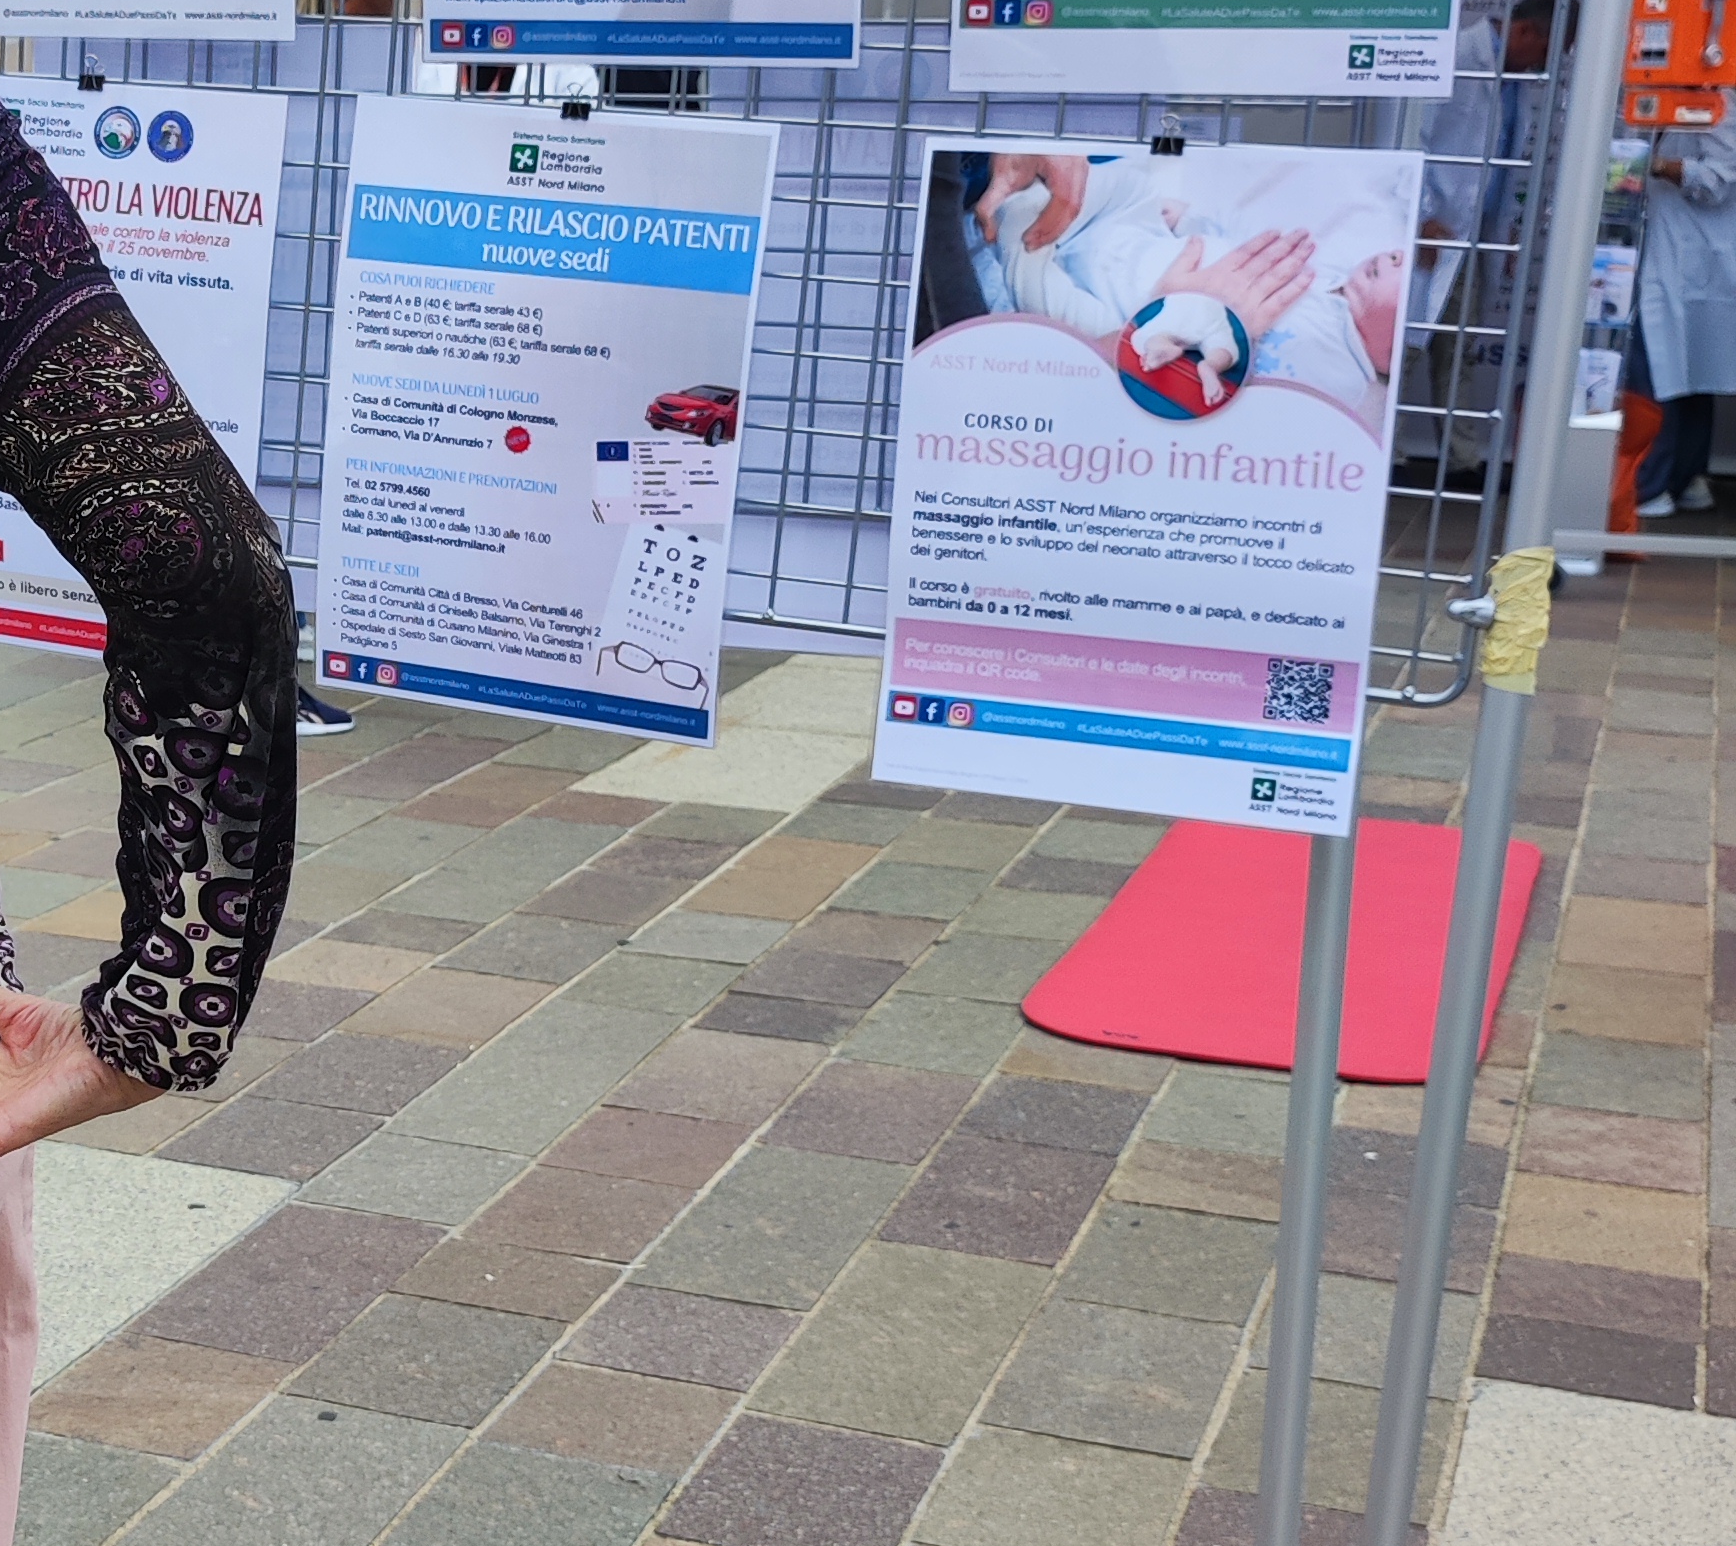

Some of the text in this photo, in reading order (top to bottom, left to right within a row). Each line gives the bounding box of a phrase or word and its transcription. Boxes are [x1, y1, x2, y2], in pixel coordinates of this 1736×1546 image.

[24, 114, 71, 127] Regione
[23, 126, 83, 139] Lombardia
[541, 150, 590, 164] Regione
[540, 161, 602, 175] Lombardia
[506, 176, 604, 192] ASST Nord Milano
[115, 181, 142, 216] LA
[152, 183, 262, 225] VIOLENZA
[359, 193, 750, 252] RINNOVO E RILASCIO PATENTI
[112, 227, 230, 247] contro la violenza
[482, 243, 610, 272] nuove sedi
[130, 269, 142, 281] di
[147, 271, 172, 284] vita
[177, 272, 233, 290] vissuta.
[351, 408, 439, 427] Via Boccaccio 17
[964, 413, 1052, 432] CORSO DI
[350, 424, 400, 440] Cormano,
[403, 429, 419, 440] Via
[486, 438, 492, 448] 7
[915, 433, 1364, 492] massaggio infantile
[643, 538, 707, 571] T O Z
[908, 594, 1072, 621] bambini da 0 a 12 mesi.
